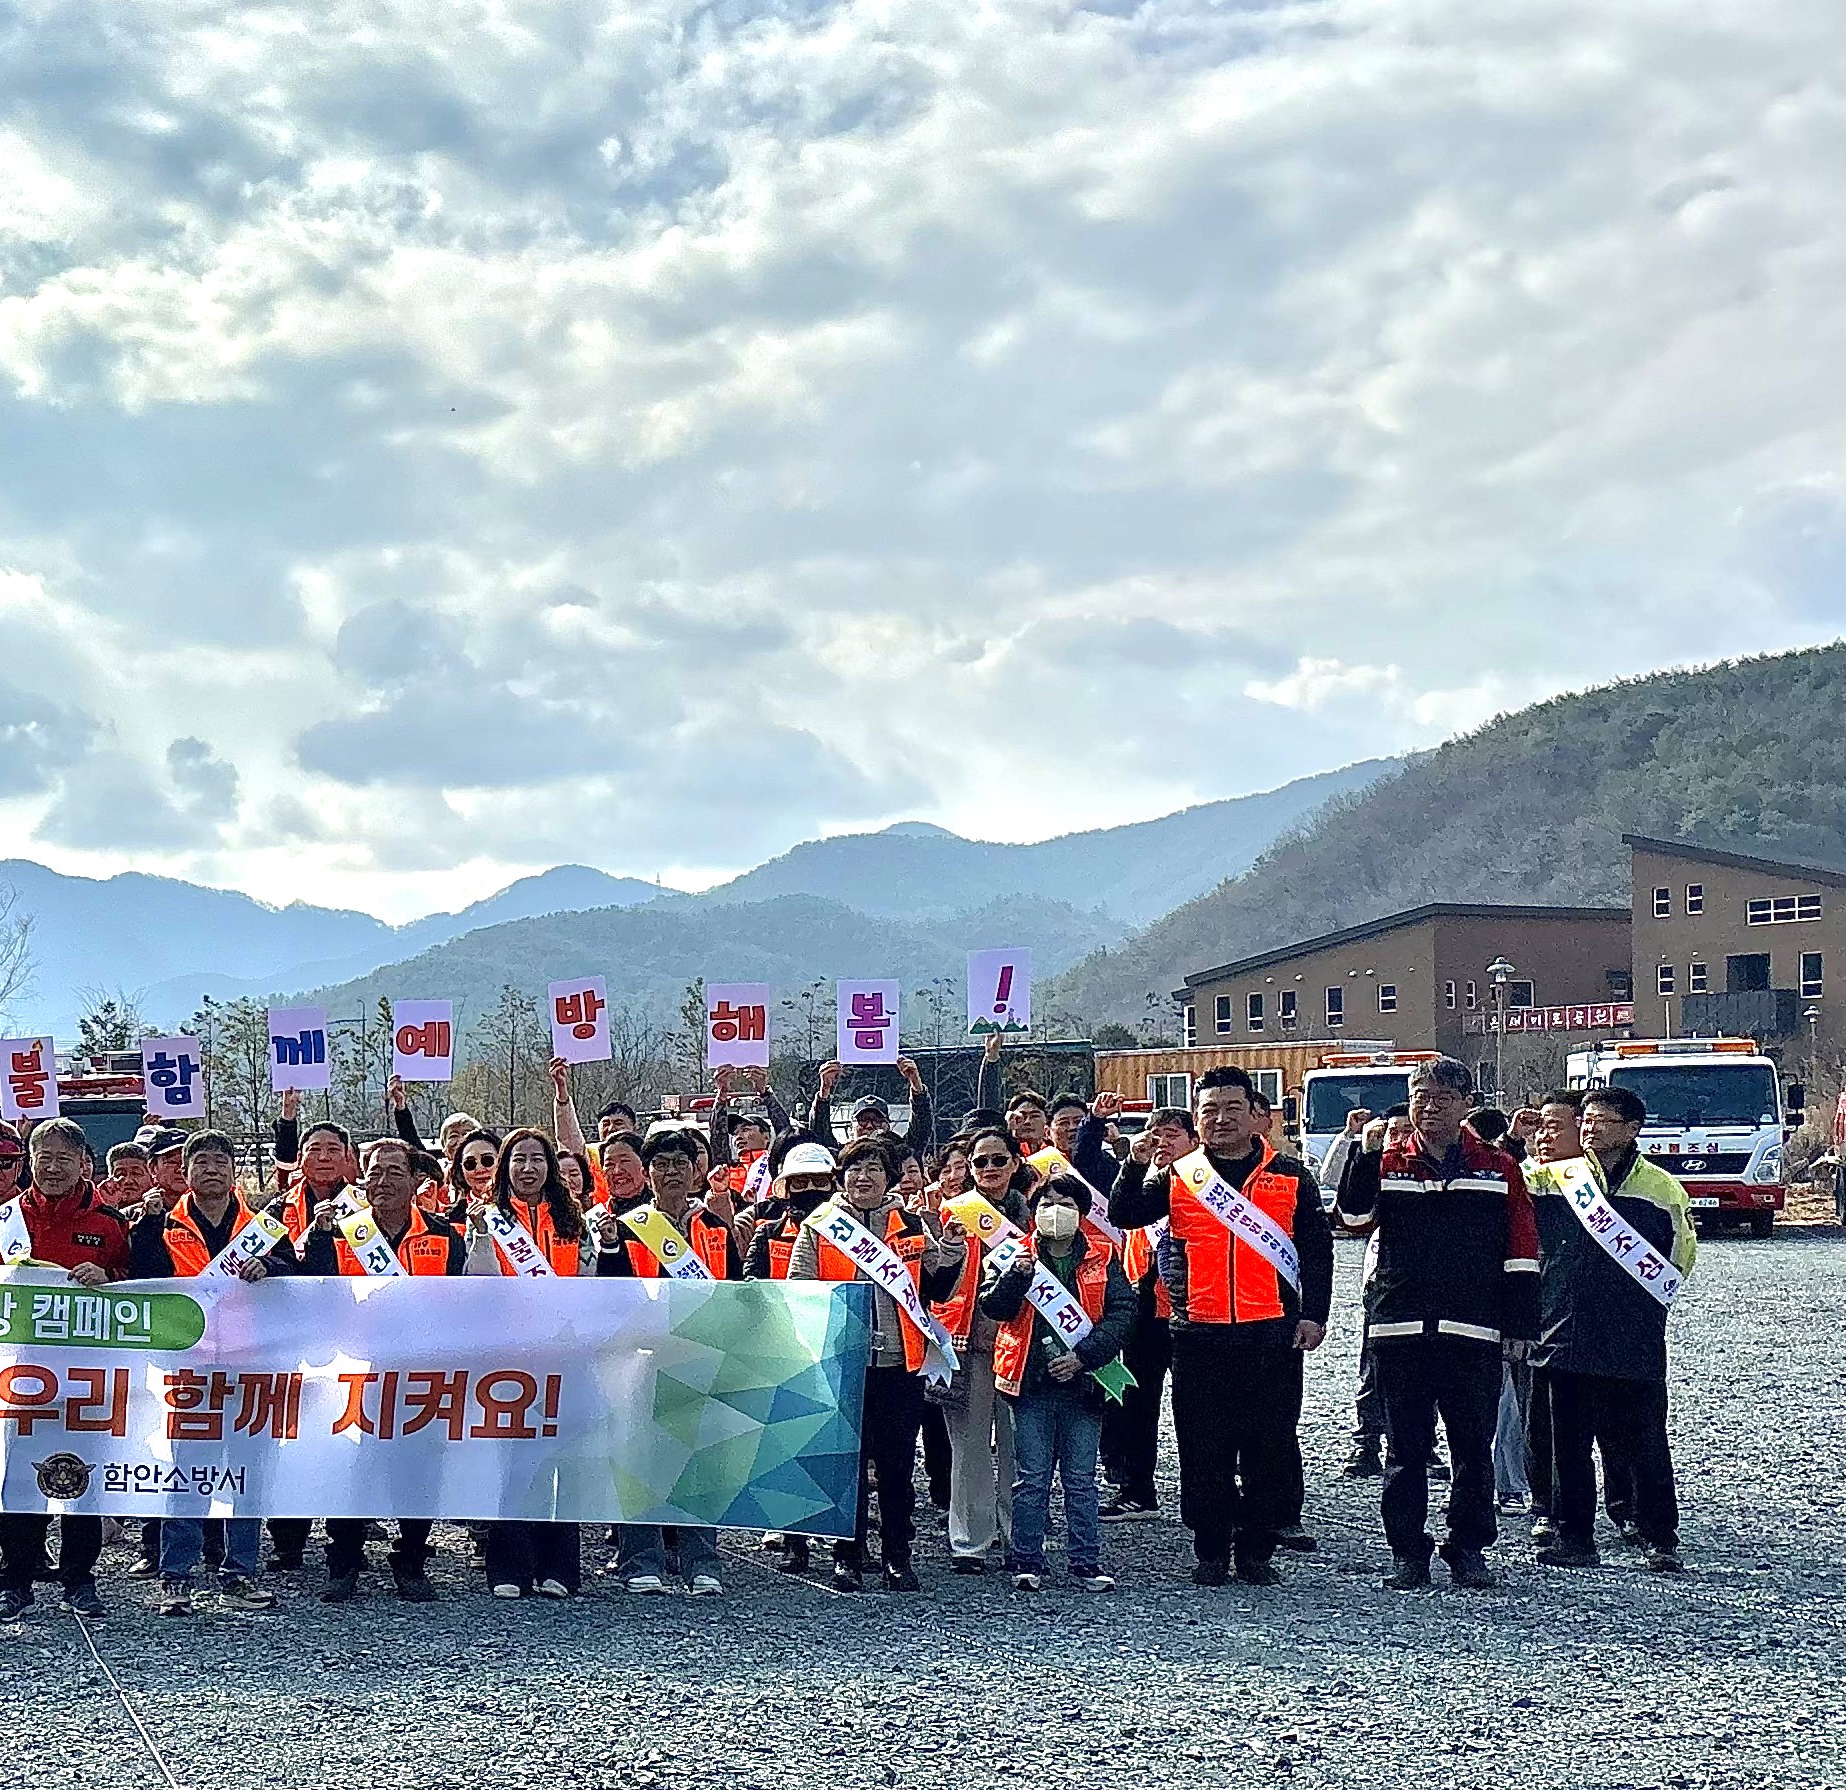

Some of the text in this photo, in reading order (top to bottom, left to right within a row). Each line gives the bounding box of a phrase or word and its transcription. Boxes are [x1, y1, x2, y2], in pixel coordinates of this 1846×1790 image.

[395, 1021, 451, 1058] 예
[556, 990, 605, 1040] 방
[710, 1001, 766, 1042] 해
[846, 991, 891, 1050] 봄
[271, 1028, 326, 1066] 께
[9, 1049, 50, 1109] 불
[146, 1051, 200, 1106] 함
[1574, 1181, 1665, 1281] 산불조심
[31, 1294, 151, 1342] 캠페인
[163, 1368, 304, 1441] 함께
[331, 1369, 562, 1441] 지켜요!
[103, 1462, 246, 1496] 함안소방서
